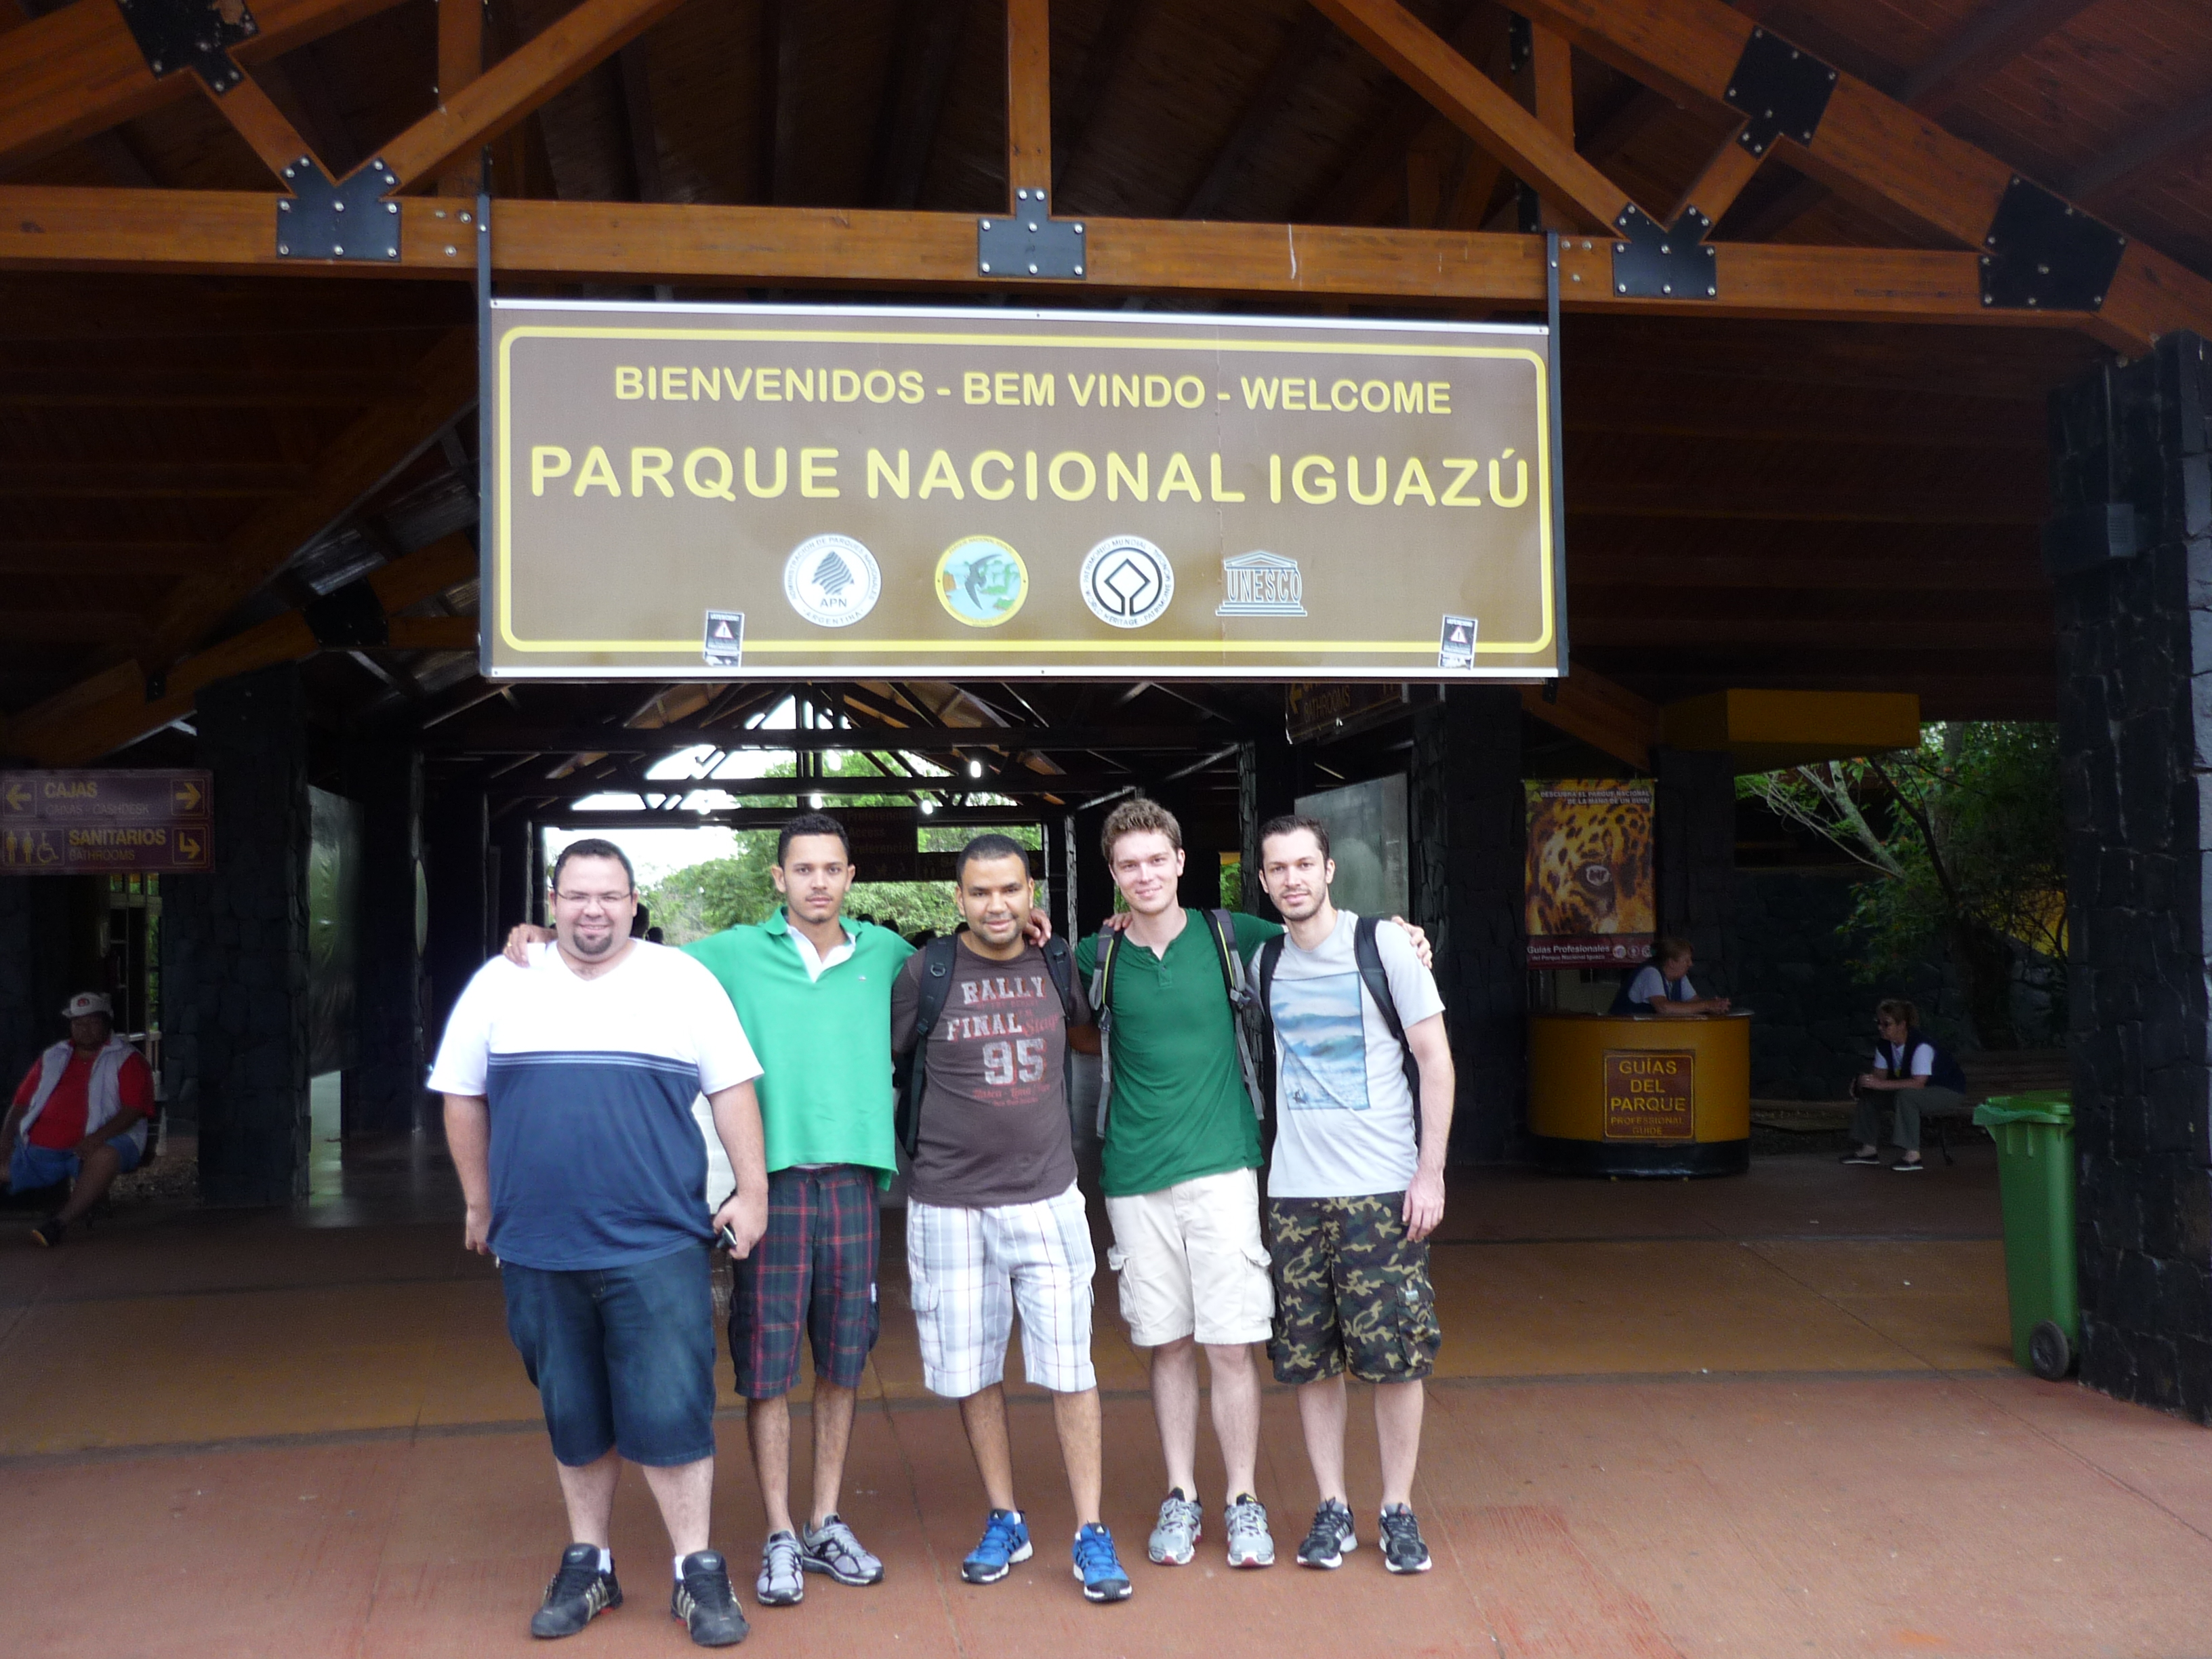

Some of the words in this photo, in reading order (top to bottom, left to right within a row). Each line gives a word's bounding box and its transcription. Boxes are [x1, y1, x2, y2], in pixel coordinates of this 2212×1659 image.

[615, 365, 924, 404] BIENVENIDOS
[964, 371, 1055, 406] BEM
[1067, 373, 1206, 408] VINDO
[1241, 376, 1452, 414] WELCOME
[531, 445, 840, 501] PARQUE
[866, 447, 1246, 502] NACIONAL
[1270, 447, 1530, 509] IGUAZÚ
[1111, 537, 1147, 550] MUNDIAL
[1227, 568, 1303, 603] UNESCO
[819, 597, 848, 608] APN
[44, 781, 98, 798] CAJAS
[1616, 790, 1650, 798] NACIONAL
[68, 828, 167, 846] SANITARIOS
[68, 849, 136, 861] BATHROOMS
[1553, 944, 1610, 954] Profesionales
[961, 976, 1046, 1005] RALLY
[947, 1012, 1023, 1042] FINAL
[982, 1038, 1046, 1085] 95
[1630, 1078, 1666, 1094] DEL
[1610, 1096, 1687, 1113] PARQUE
[1632, 1127, 1663, 1135] GUIDE
